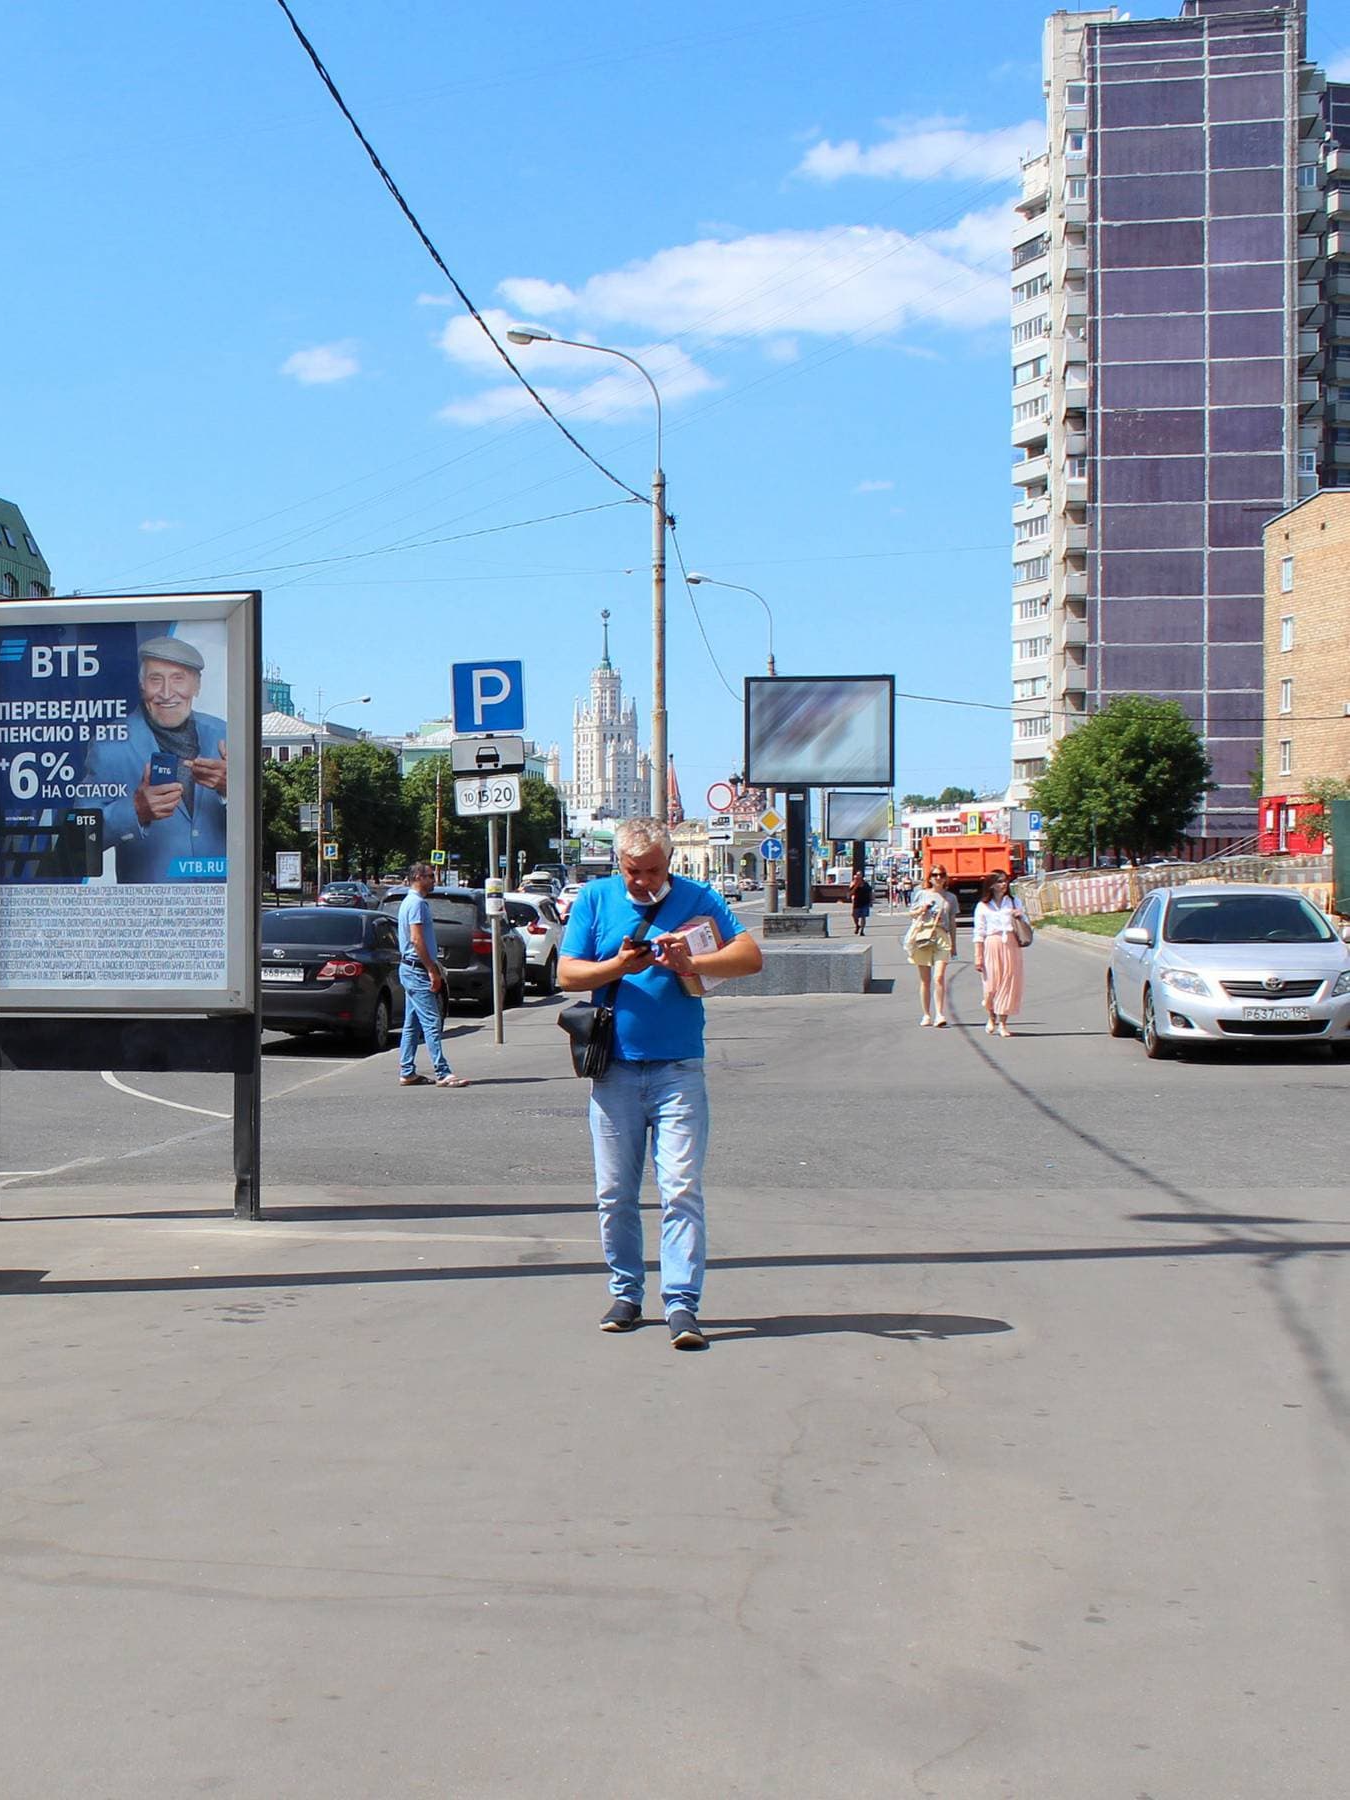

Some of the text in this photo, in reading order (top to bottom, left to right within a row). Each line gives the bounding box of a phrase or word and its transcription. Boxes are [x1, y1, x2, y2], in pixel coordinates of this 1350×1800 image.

[31, 645, 100, 678] ВТБ
[472, 668, 511, 726] P
[79, 725, 90, 742] В
[95, 724, 129, 742] ВТБ
[41, 783, 128, 798] НА ОСТАТОК
[464, 787, 513, 803] 10 15 20
[76, 815, 96, 826] ВТБ
[178, 861, 225, 874] VTB.RU
